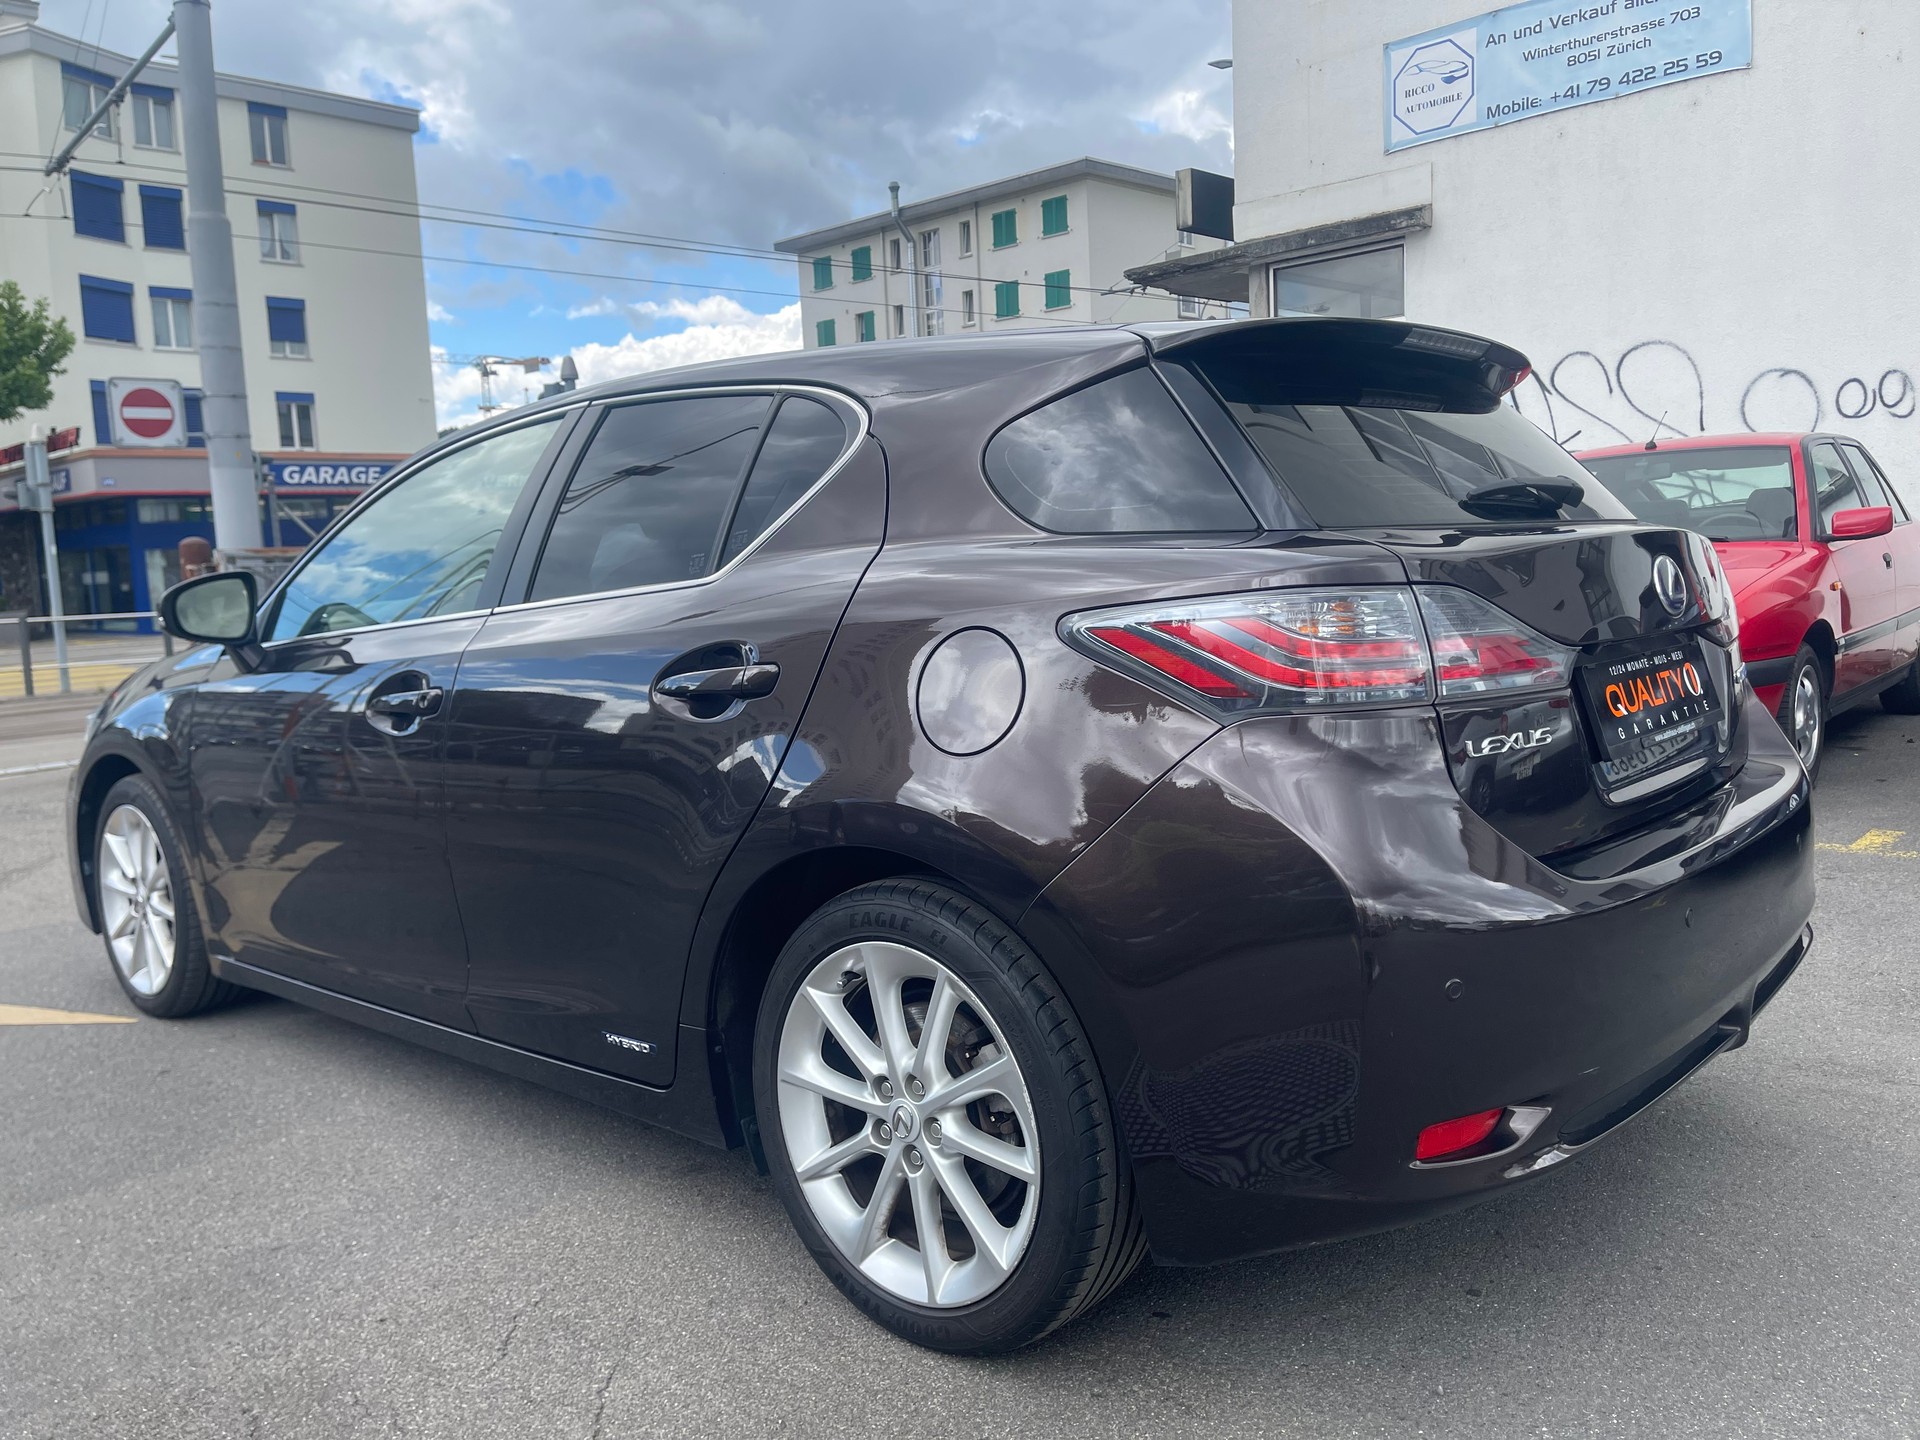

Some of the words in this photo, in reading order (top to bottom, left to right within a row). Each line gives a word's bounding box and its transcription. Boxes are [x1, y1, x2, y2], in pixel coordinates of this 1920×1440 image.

[1485, 33, 1506, 48] An
[1513, 20, 1542, 39] und
[1549, 0, 1617, 29] Verkauf
[1523, 18, 1665, 61] Winterthurerstrasse
[1670, 6, 1701, 24] 703
[1567, 50, 1600, 67] 8051
[1606, 37, 1652, 57] Zürich
[1405, 83, 1435, 98] RICCO
[1486, 96, 1542, 120] Mobile:
[1551, 84, 1580, 103] +41
[1587, 77, 1611, 95] 79
[1618, 65, 1656, 86] 422
[1663, 58, 1689, 77] 25
[1696, 50, 1723, 68] 59
[1405, 92, 1463, 114] AUTOMOBILE
[282, 465, 382, 485] GARAGE
[1609, 664, 1626, 676] 12/24
[1626, 658, 1649, 672] MONATE
[1653, 654, 1667, 665] MOIS
[1671, 651, 1684, 661] MESI
[1618, 700, 1709, 739] GARANTIE
[1465, 727, 1552, 757] LEXUS
[849, 911, 914, 933] EAGLE
[605, 1033, 650, 1053] HYBRID
